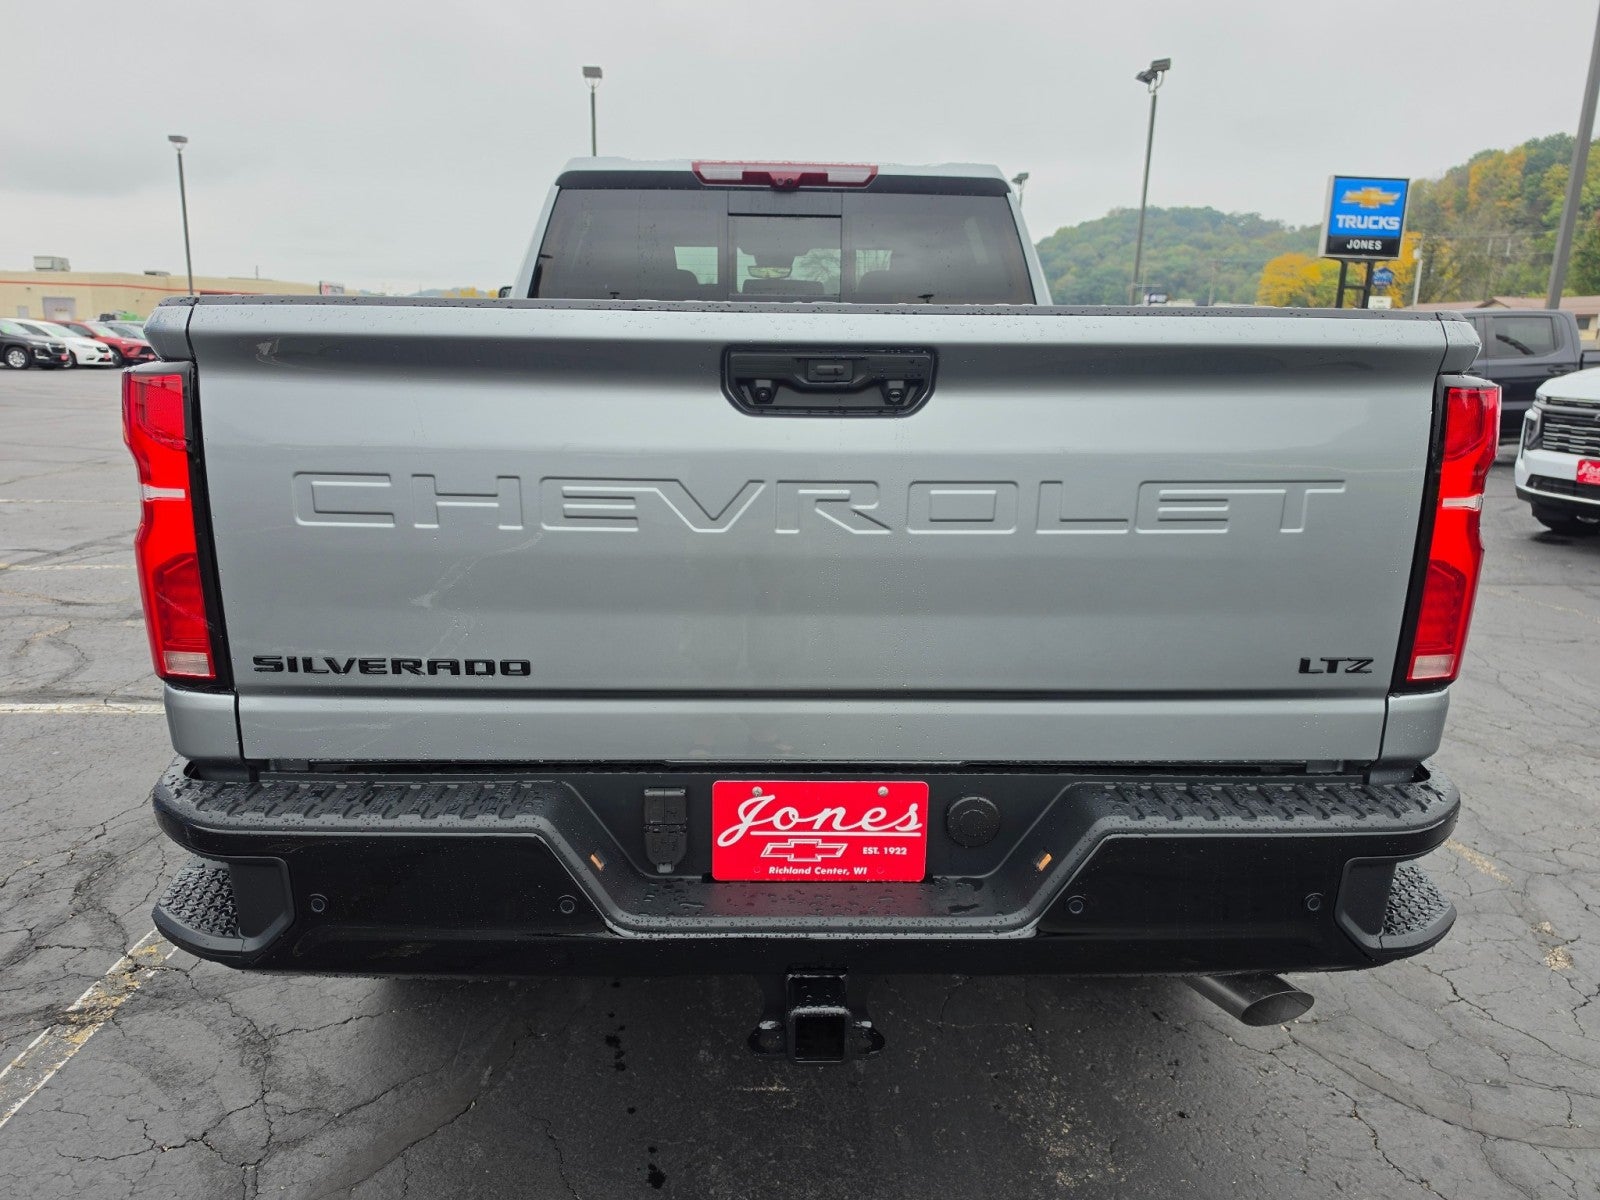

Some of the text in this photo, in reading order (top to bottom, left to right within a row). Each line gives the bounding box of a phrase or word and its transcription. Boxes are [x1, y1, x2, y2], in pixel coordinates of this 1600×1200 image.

[1335, 214, 1400, 230] TRUCKS
[1346, 239, 1382, 251] JONES
[293, 471, 1346, 535] CHEVROLET
[252, 655, 531, 676] SILVERADO
[1298, 657, 1374, 674] LTZ
[717, 794, 923, 847] Jones
[862, 846, 908, 856] EST. 1922
[768, 866, 868, 876] Richland Center, WI
